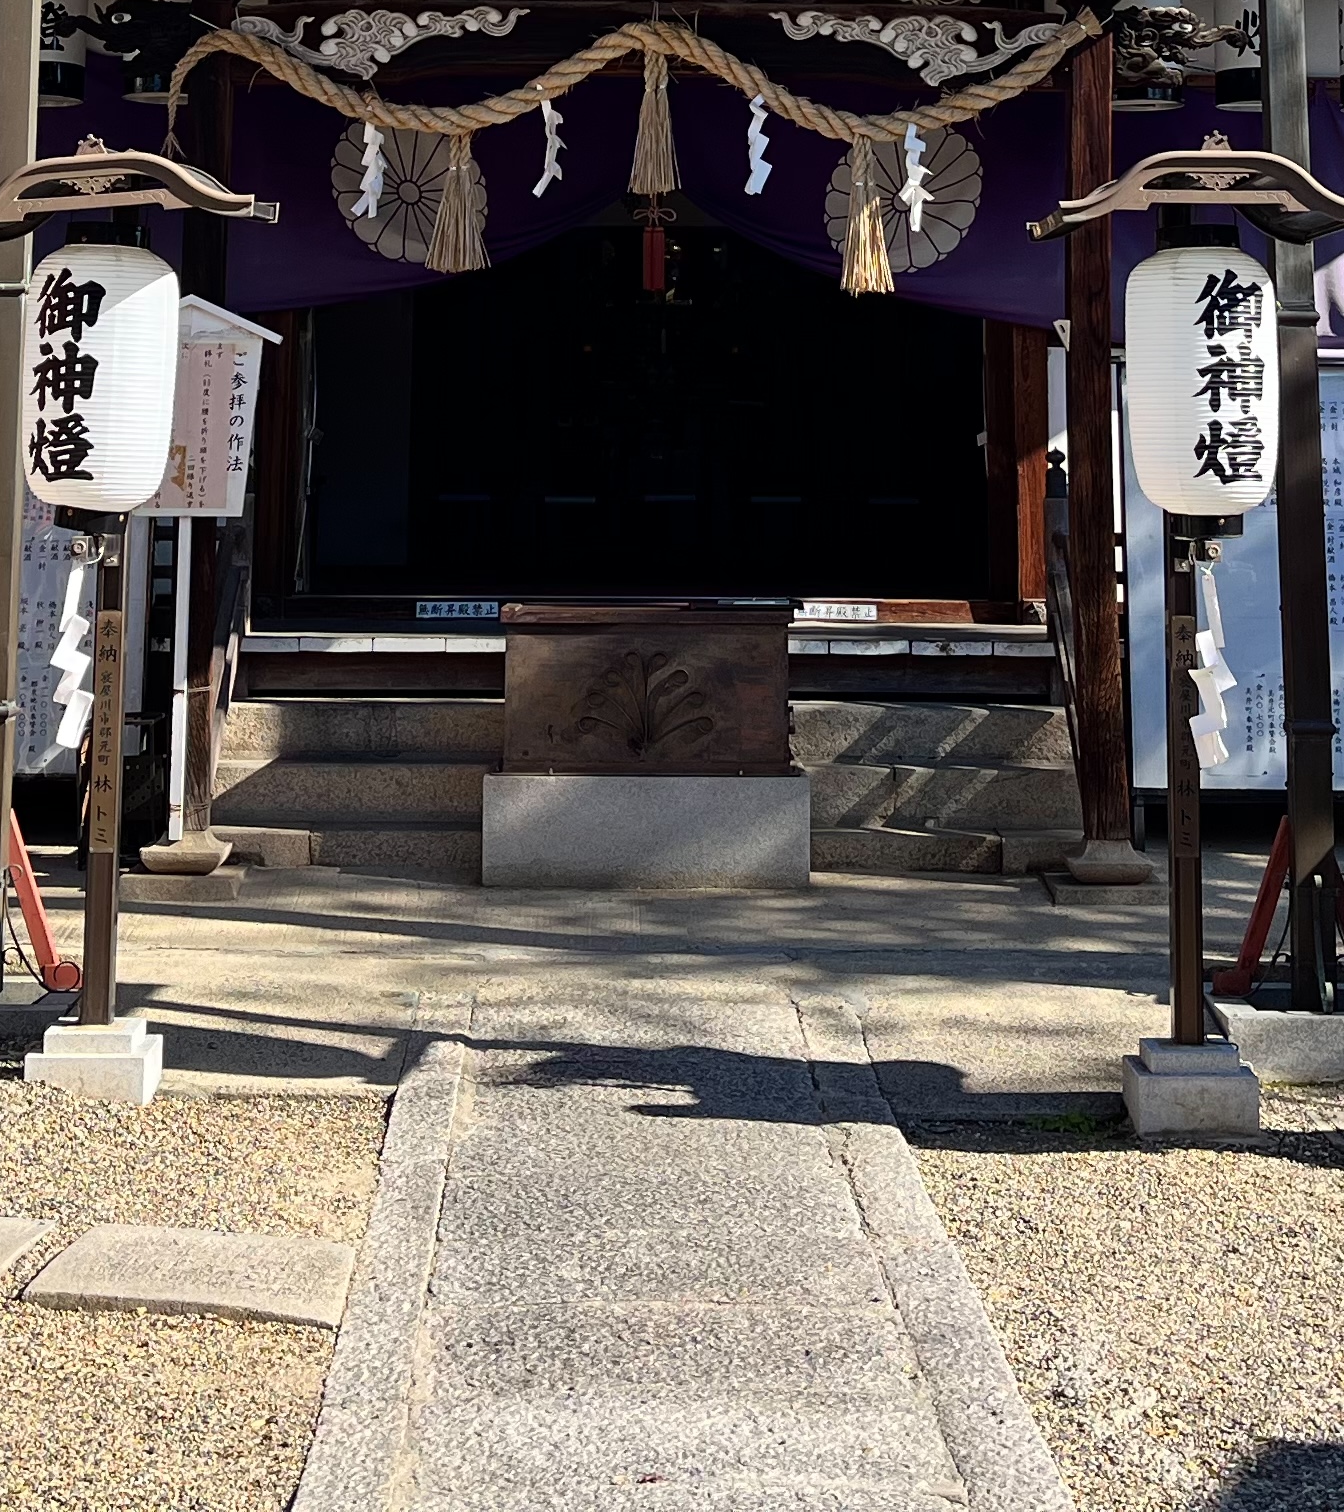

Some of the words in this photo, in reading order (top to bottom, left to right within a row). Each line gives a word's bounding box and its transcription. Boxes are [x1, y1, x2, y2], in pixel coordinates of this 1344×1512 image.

[29, 268, 106, 482] 御神燈
[226, 351, 248, 472] ご参拝の作法
[1192, 269, 1265, 485] 御神燈
[97, 619, 118, 663] 奉納
[418, 603, 497, 617] 無断昇殿禁止
[1174, 624, 1195, 668] 奉納
